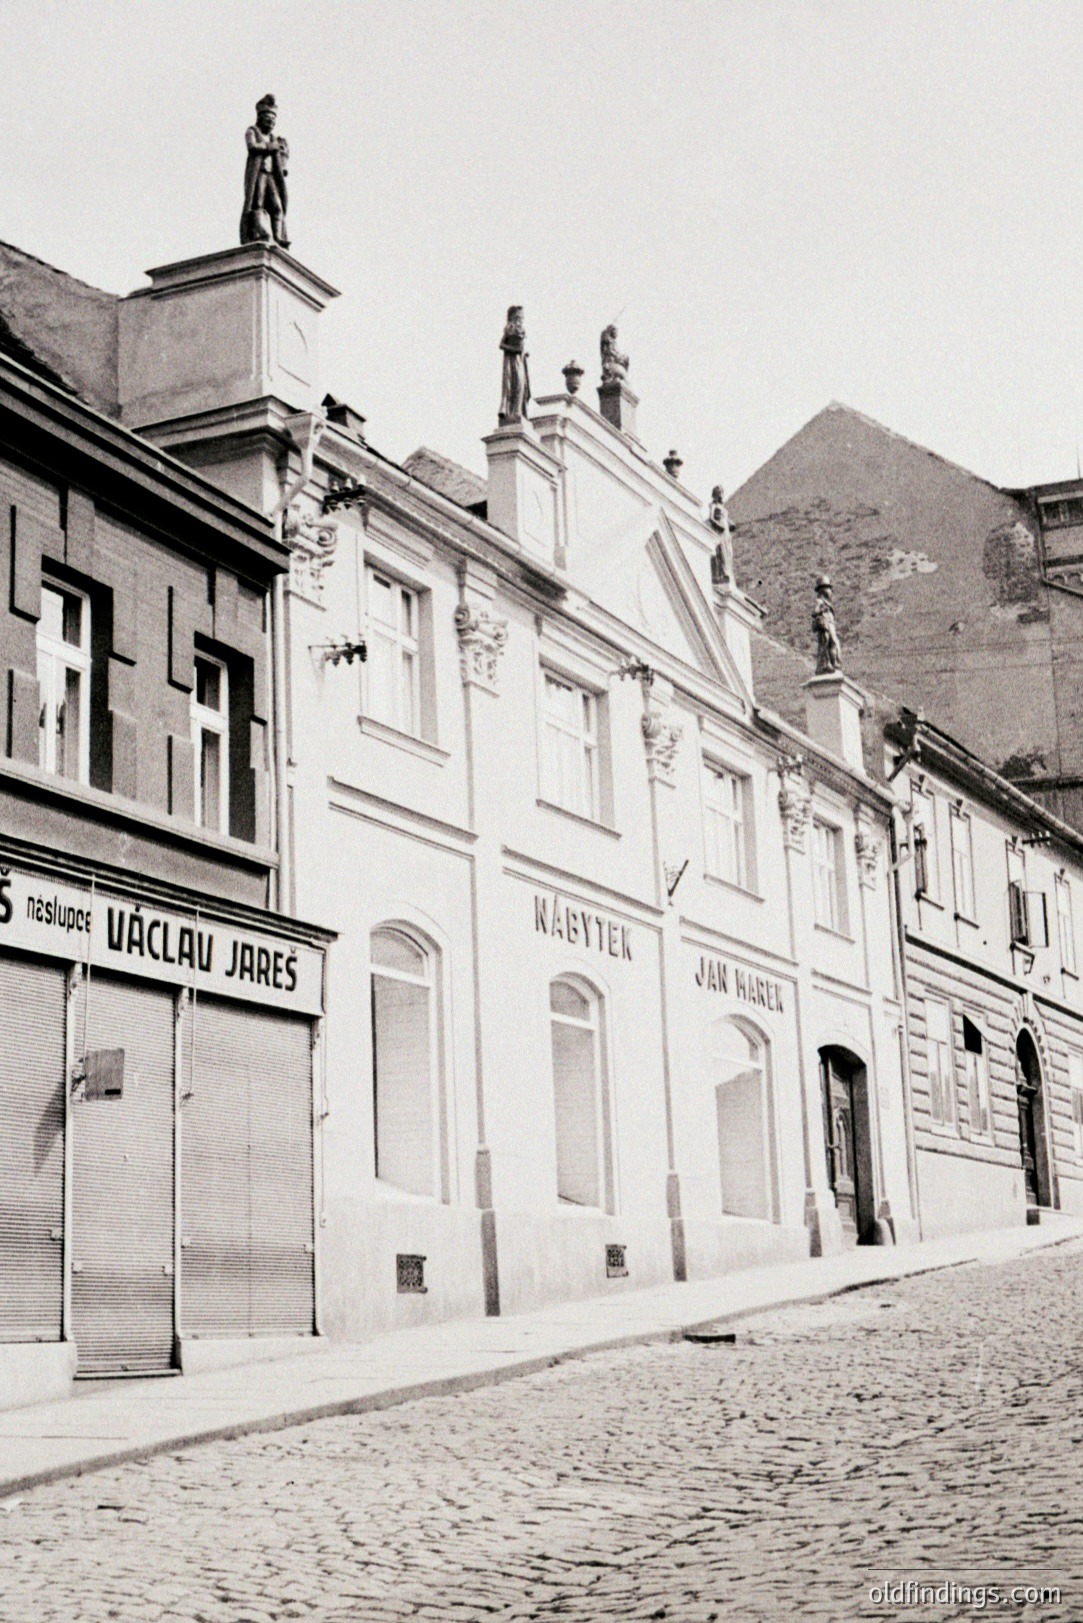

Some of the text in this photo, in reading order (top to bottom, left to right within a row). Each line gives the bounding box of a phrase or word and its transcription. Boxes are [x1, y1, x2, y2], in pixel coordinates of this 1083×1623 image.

[225, 939, 297, 991] JAREŠ
[695, 956, 784, 1013] JAN MAREK
